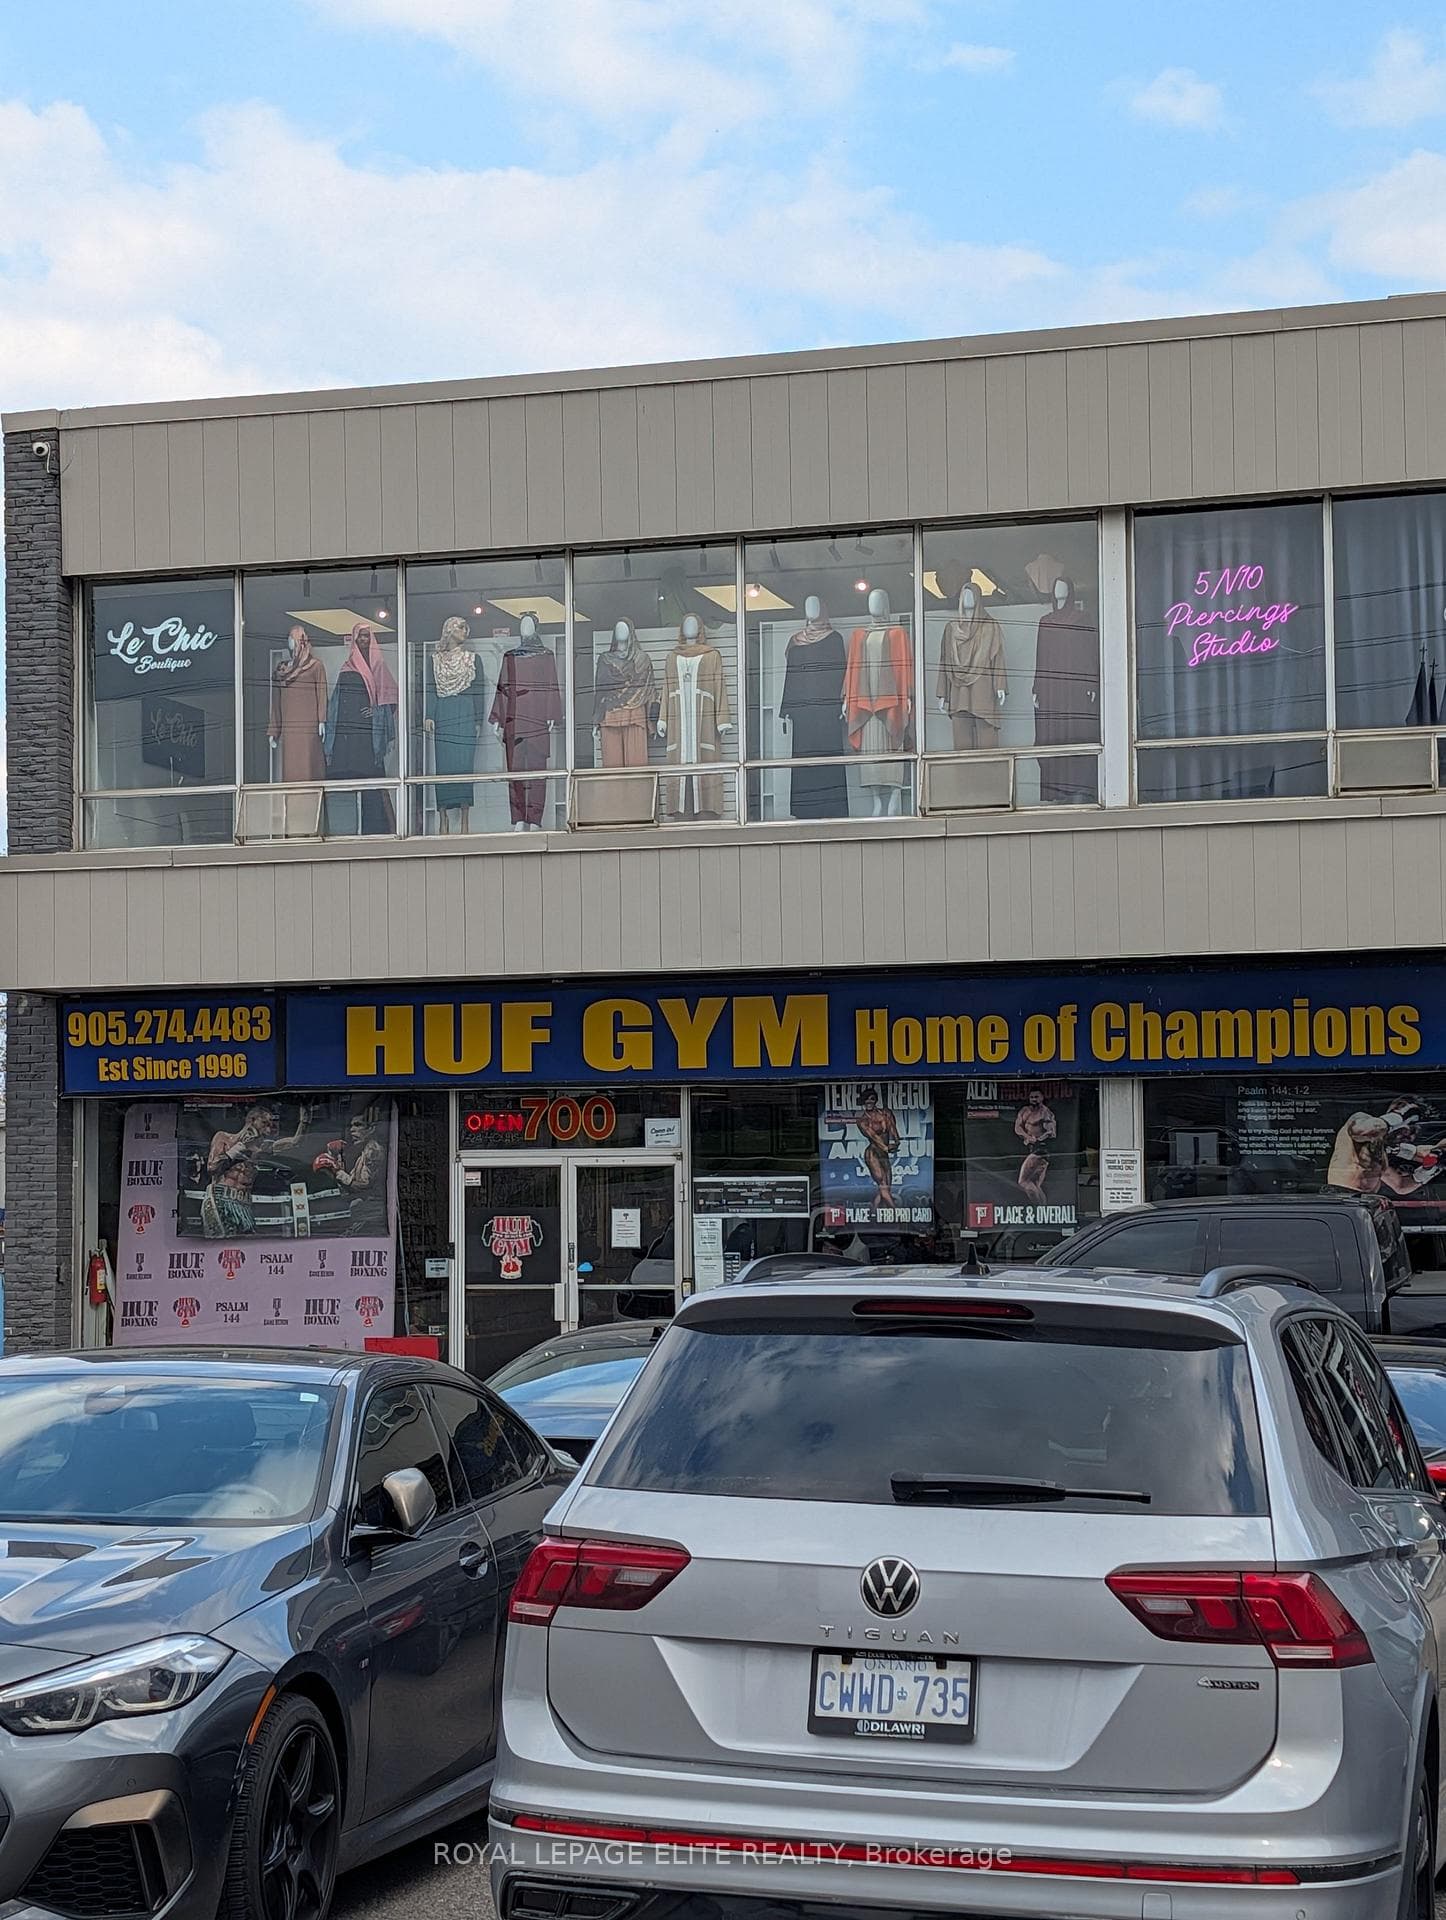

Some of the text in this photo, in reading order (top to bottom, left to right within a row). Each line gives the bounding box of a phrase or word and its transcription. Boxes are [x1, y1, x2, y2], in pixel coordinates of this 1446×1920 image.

[1164, 602, 1299, 636] Piercings
[108, 617, 218, 664] Le Chic
[1188, 630, 1280, 667] Studio
[134, 656, 192, 674] Boutique
[67, 1005, 272, 1047] 905.274.4483
[346, 994, 1421, 1076] HUF GYM Home of Champions
[98, 1053, 248, 1081] Est Since 1996
[1238, 1086, 1267, 1095] Psalm
[466, 1112, 523, 1133] OPEN
[520, 1096, 617, 1141] 700
[128, 1160, 163, 1177] HUF
[127, 1177, 162, 1186] BOXING
[845, 1208, 871, 1223] PLACE
[994, 1206, 1024, 1224] PLACE
[1025, 1206, 1036, 1224] &
[1036, 1206, 1077, 1224] OVERALL
[168, 1253, 205, 1269] HUF
[260, 1254, 293, 1264] PSALM
[351, 1251, 388, 1267] HUF
[168, 1270, 204, 1279] BOXING
[268, 1265, 284, 1275] 144
[350, 1268, 387, 1277] BOXING
[122, 1300, 159, 1317] HUF
[216, 1302, 249, 1312] PSALM
[304, 1299, 340, 1315] HUF
[121, 1317, 158, 1327] BOXING
[223, 1314, 240, 1323] 144
[304, 1316, 340, 1325] BOXING
[818, 1624, 960, 1645] TIGUAN
[864, 1659, 927, 1672] ONTARIO
[819, 1671, 969, 1719] CWWD 735
[870, 1722, 925, 1735] DILAWRI
